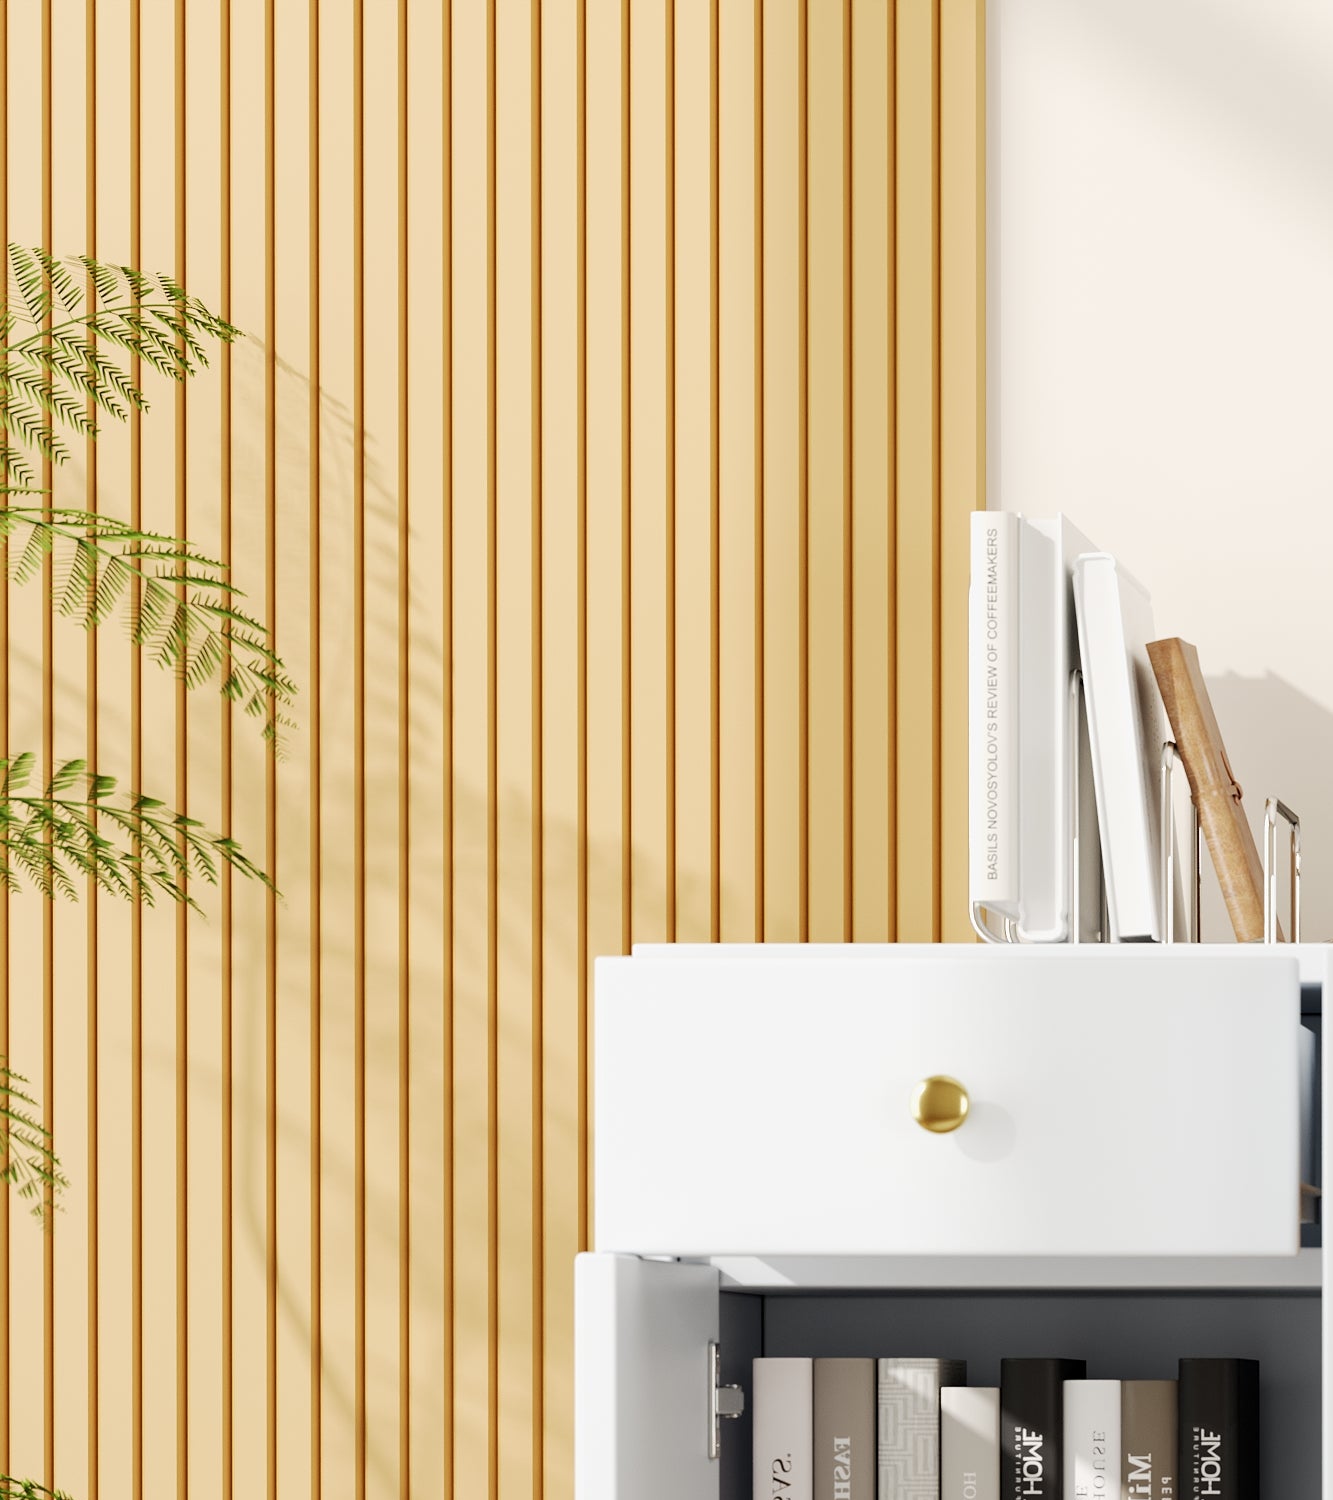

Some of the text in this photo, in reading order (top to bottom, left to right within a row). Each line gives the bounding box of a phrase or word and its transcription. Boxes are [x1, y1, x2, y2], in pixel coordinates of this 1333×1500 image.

[986, 528, 999, 880] BASILS NOVOSYOLOV'S REVIEW OF COFFEEMAKERS
